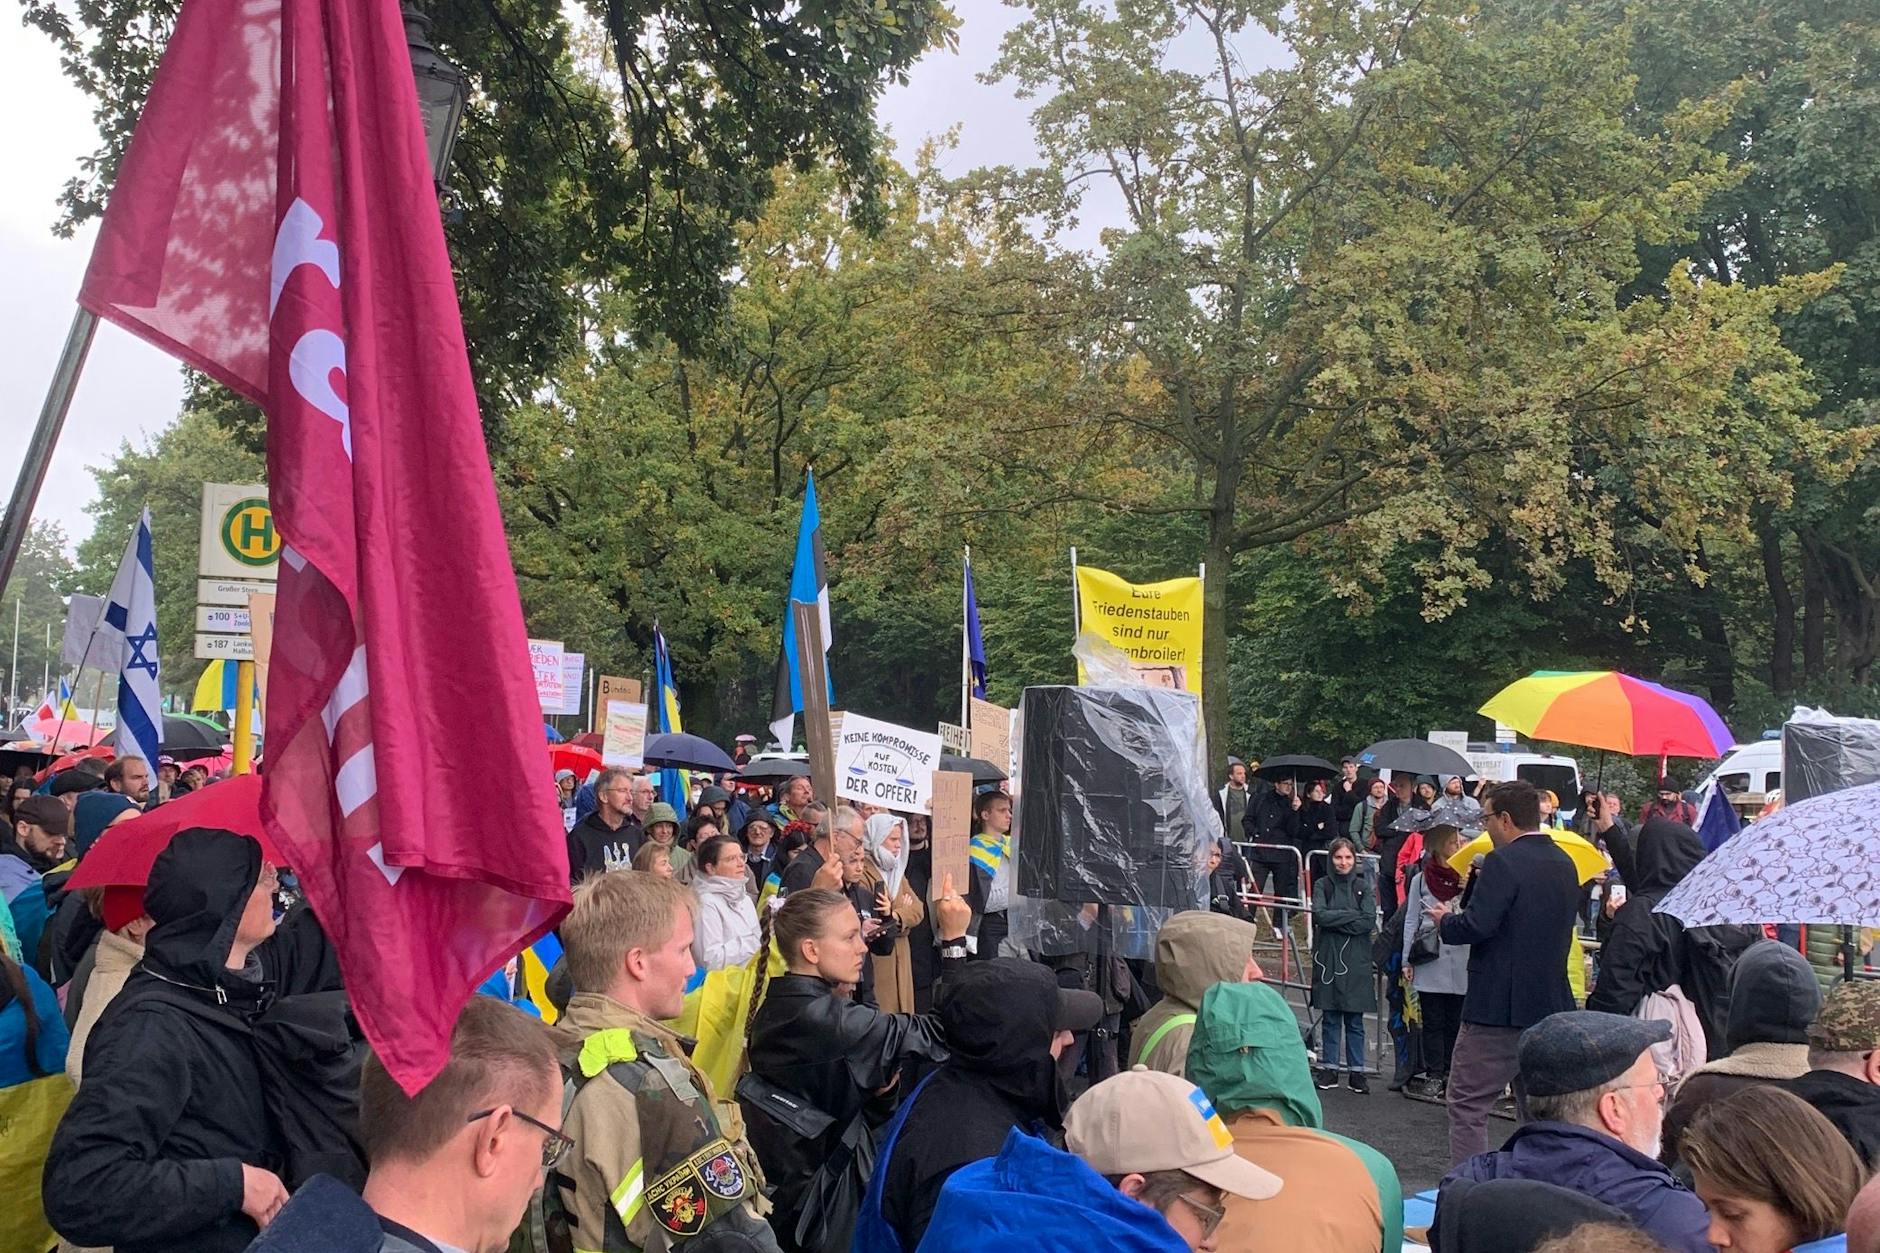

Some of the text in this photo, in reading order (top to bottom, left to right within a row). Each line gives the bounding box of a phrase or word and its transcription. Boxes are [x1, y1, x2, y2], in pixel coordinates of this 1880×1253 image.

[240, 513, 273, 552] H
[217, 585, 240, 593] Großer
[214, 612, 230, 621] 100
[1112, 624, 1170, 641] sind nur
[214, 639, 229, 649] 187
[844, 732, 870, 744] KEINE
[872, 732, 932, 766] KOMPROMISSE
[874, 752, 891, 762] AUF
[867, 761, 899, 775] KOSTEN
[845, 775, 869, 795] DER
[874, 782, 918, 805] OPFER!
